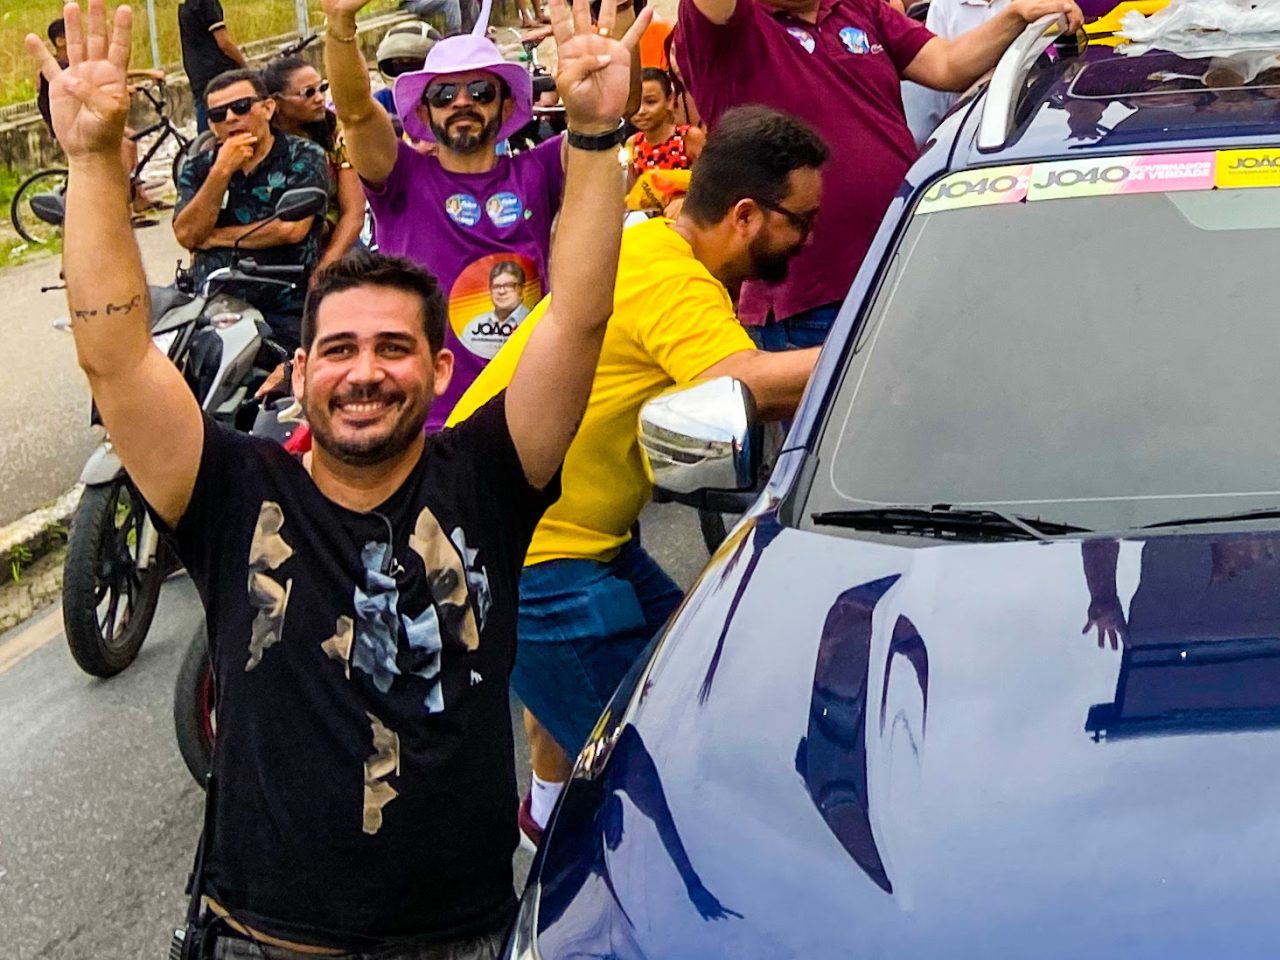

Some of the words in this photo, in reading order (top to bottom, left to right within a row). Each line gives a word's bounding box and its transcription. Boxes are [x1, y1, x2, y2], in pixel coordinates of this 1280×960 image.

[1034, 165, 1131, 189] JO40
[1147, 167, 1211, 180] VERDADE
[924, 175, 1019, 202] JO40
